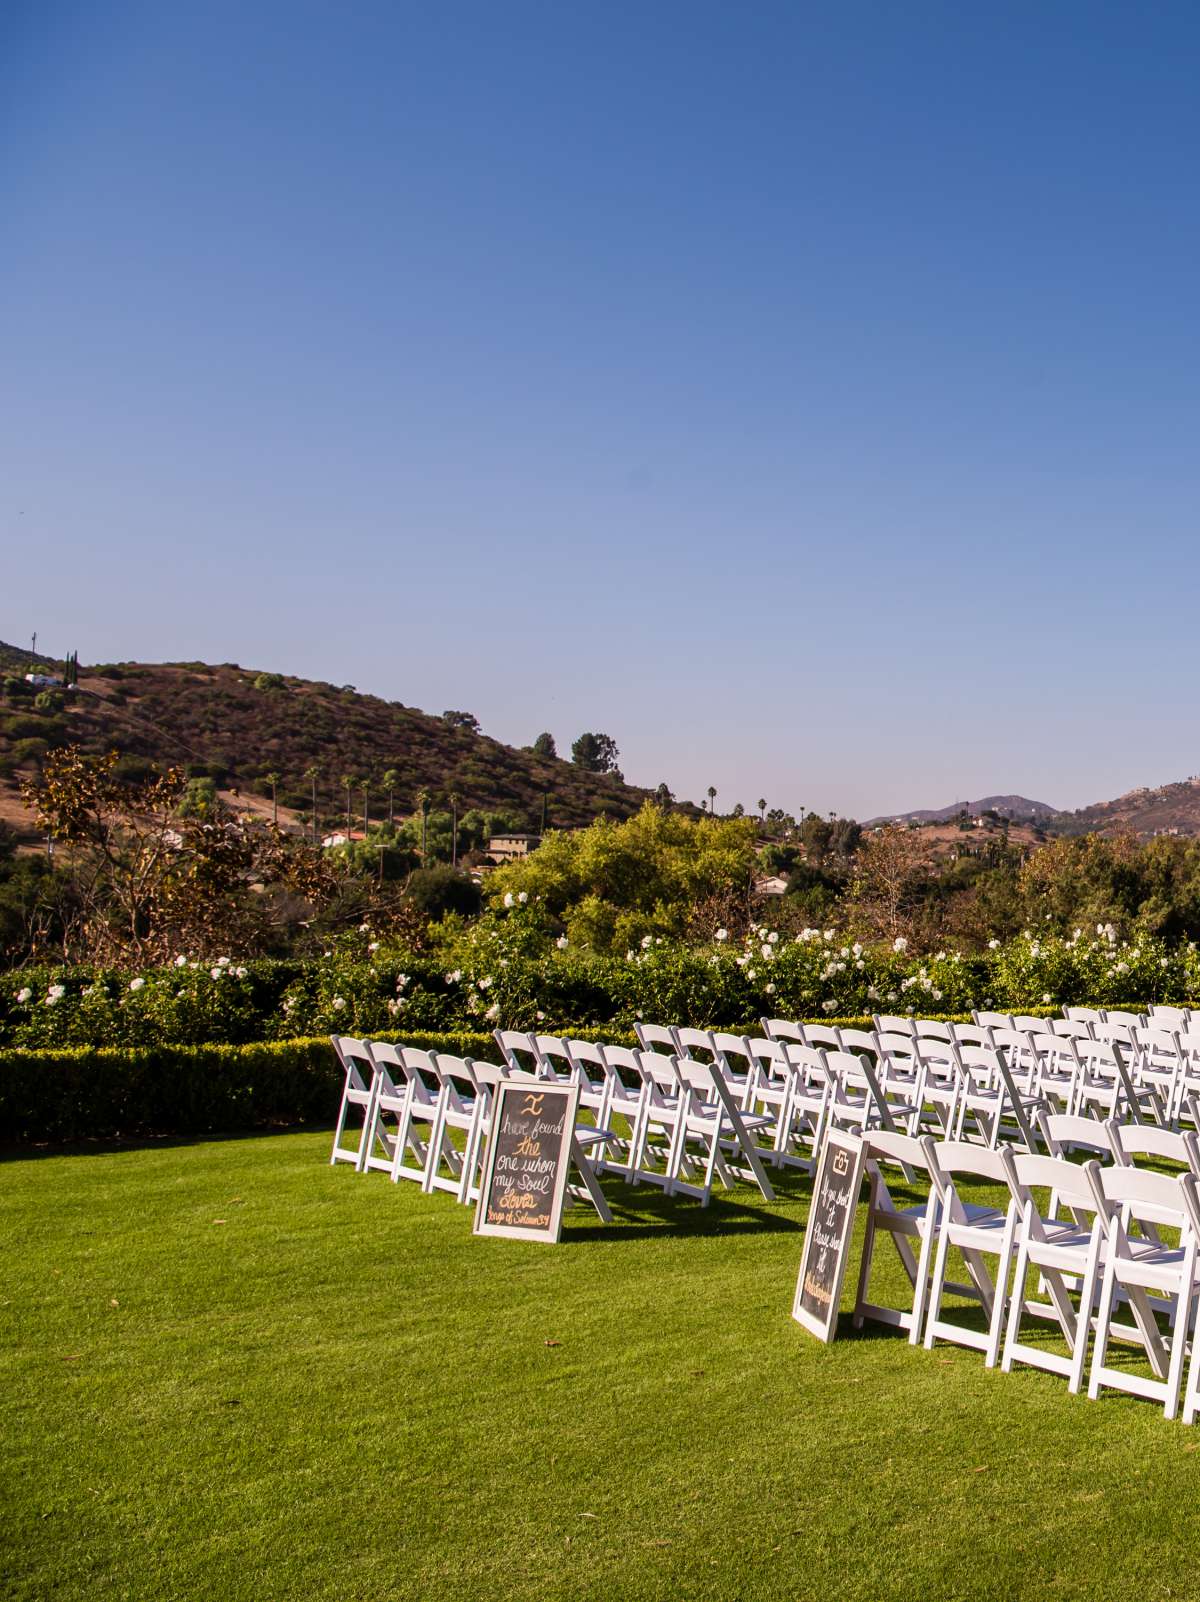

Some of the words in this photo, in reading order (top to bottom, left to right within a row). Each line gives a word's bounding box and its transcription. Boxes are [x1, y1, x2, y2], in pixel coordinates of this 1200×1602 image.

[532, 1113, 565, 1140] found
[512, 1136, 541, 1156] the
[521, 1157, 556, 1178] whom
